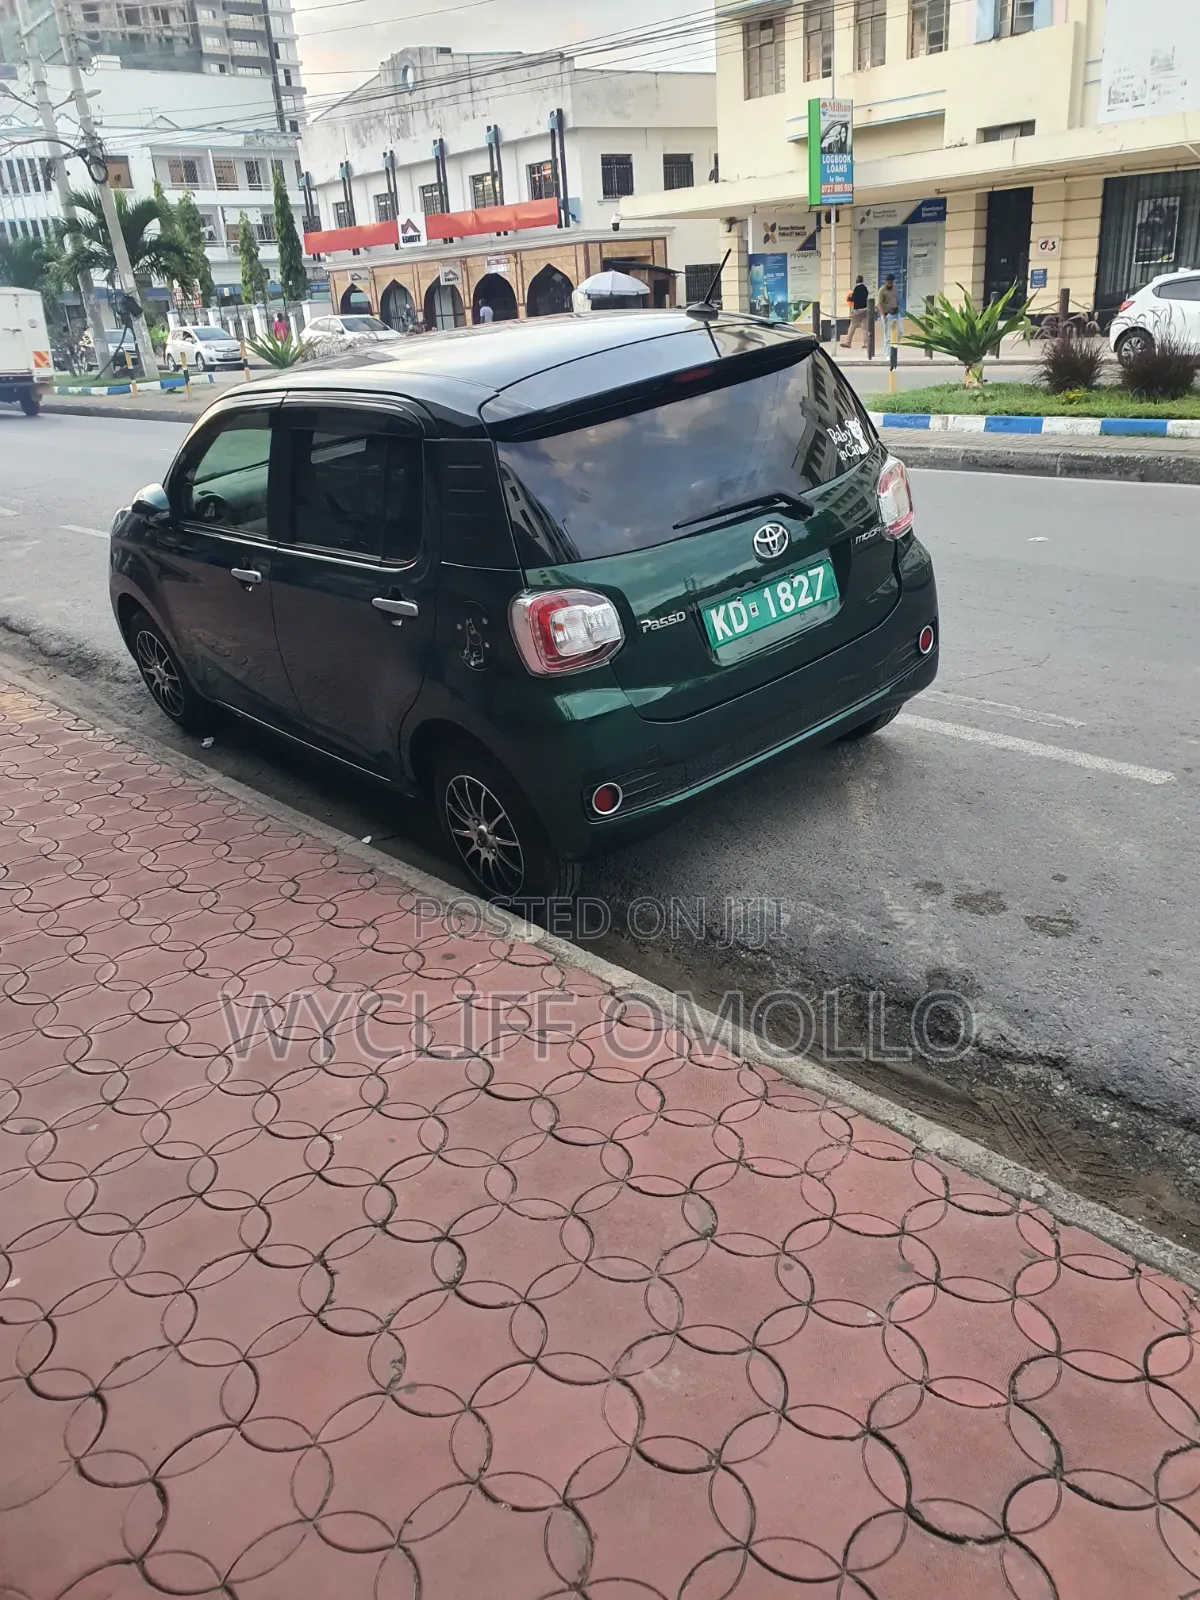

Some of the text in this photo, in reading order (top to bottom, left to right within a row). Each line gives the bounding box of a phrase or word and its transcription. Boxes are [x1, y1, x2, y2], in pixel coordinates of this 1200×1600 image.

[822, 155, 851, 164] LOGBOOK
[827, 164, 847, 173] LOANS
[821, 185, 834, 193] 0727
[827, 424, 853, 446] Baby
[763, 566, 825, 618] 1827
